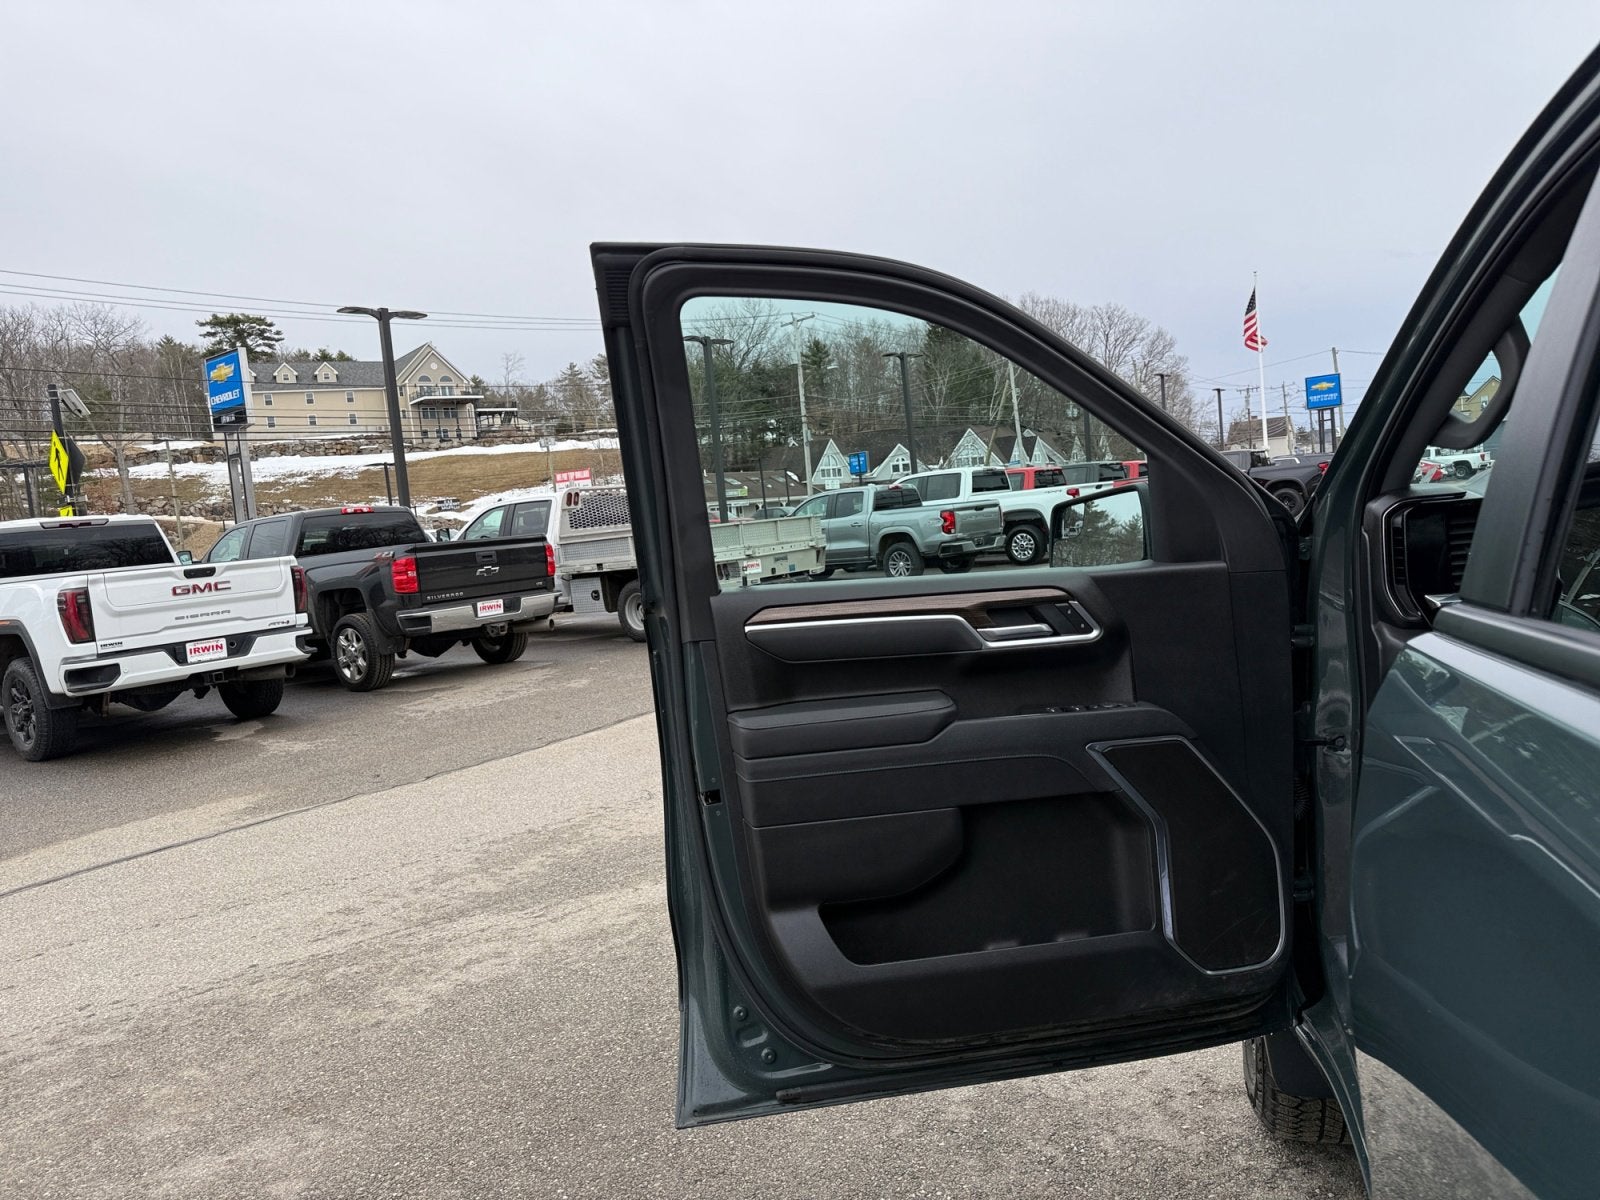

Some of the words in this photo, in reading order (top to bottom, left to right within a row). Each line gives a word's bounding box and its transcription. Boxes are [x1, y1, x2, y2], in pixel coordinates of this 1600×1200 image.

[211, 389, 240, 405] CHEVROLET
[172, 580, 231, 596] GMC
[426, 592, 464, 600] SILVERADO
[479, 603, 502, 611] IRWIN
[174, 610, 231, 620] SIERRA
[189, 643, 224, 655] IRWIN
